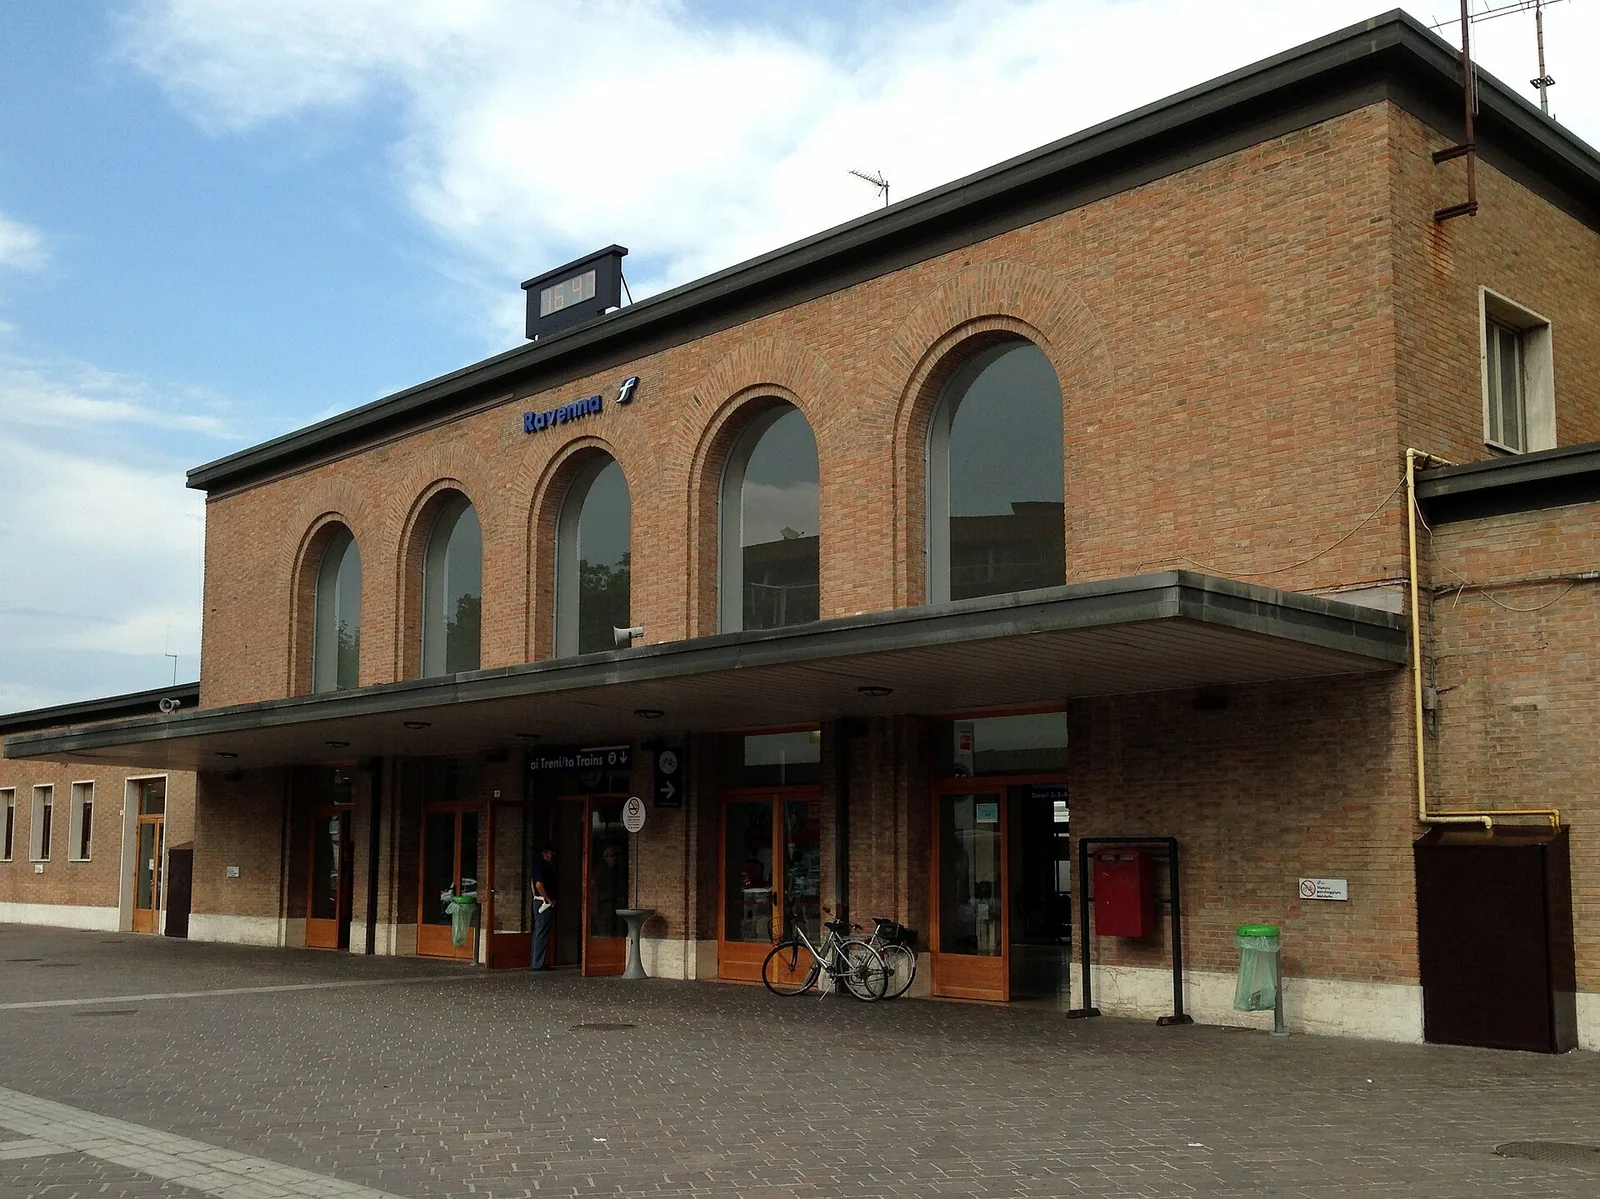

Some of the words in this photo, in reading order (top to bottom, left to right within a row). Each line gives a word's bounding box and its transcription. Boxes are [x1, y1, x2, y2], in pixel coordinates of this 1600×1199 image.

[524, 395, 602, 433] Ravenna
[530, 757, 539, 770] ai
[541, 756, 574, 769] Treni/to
[576, 754, 603, 767] Trains
